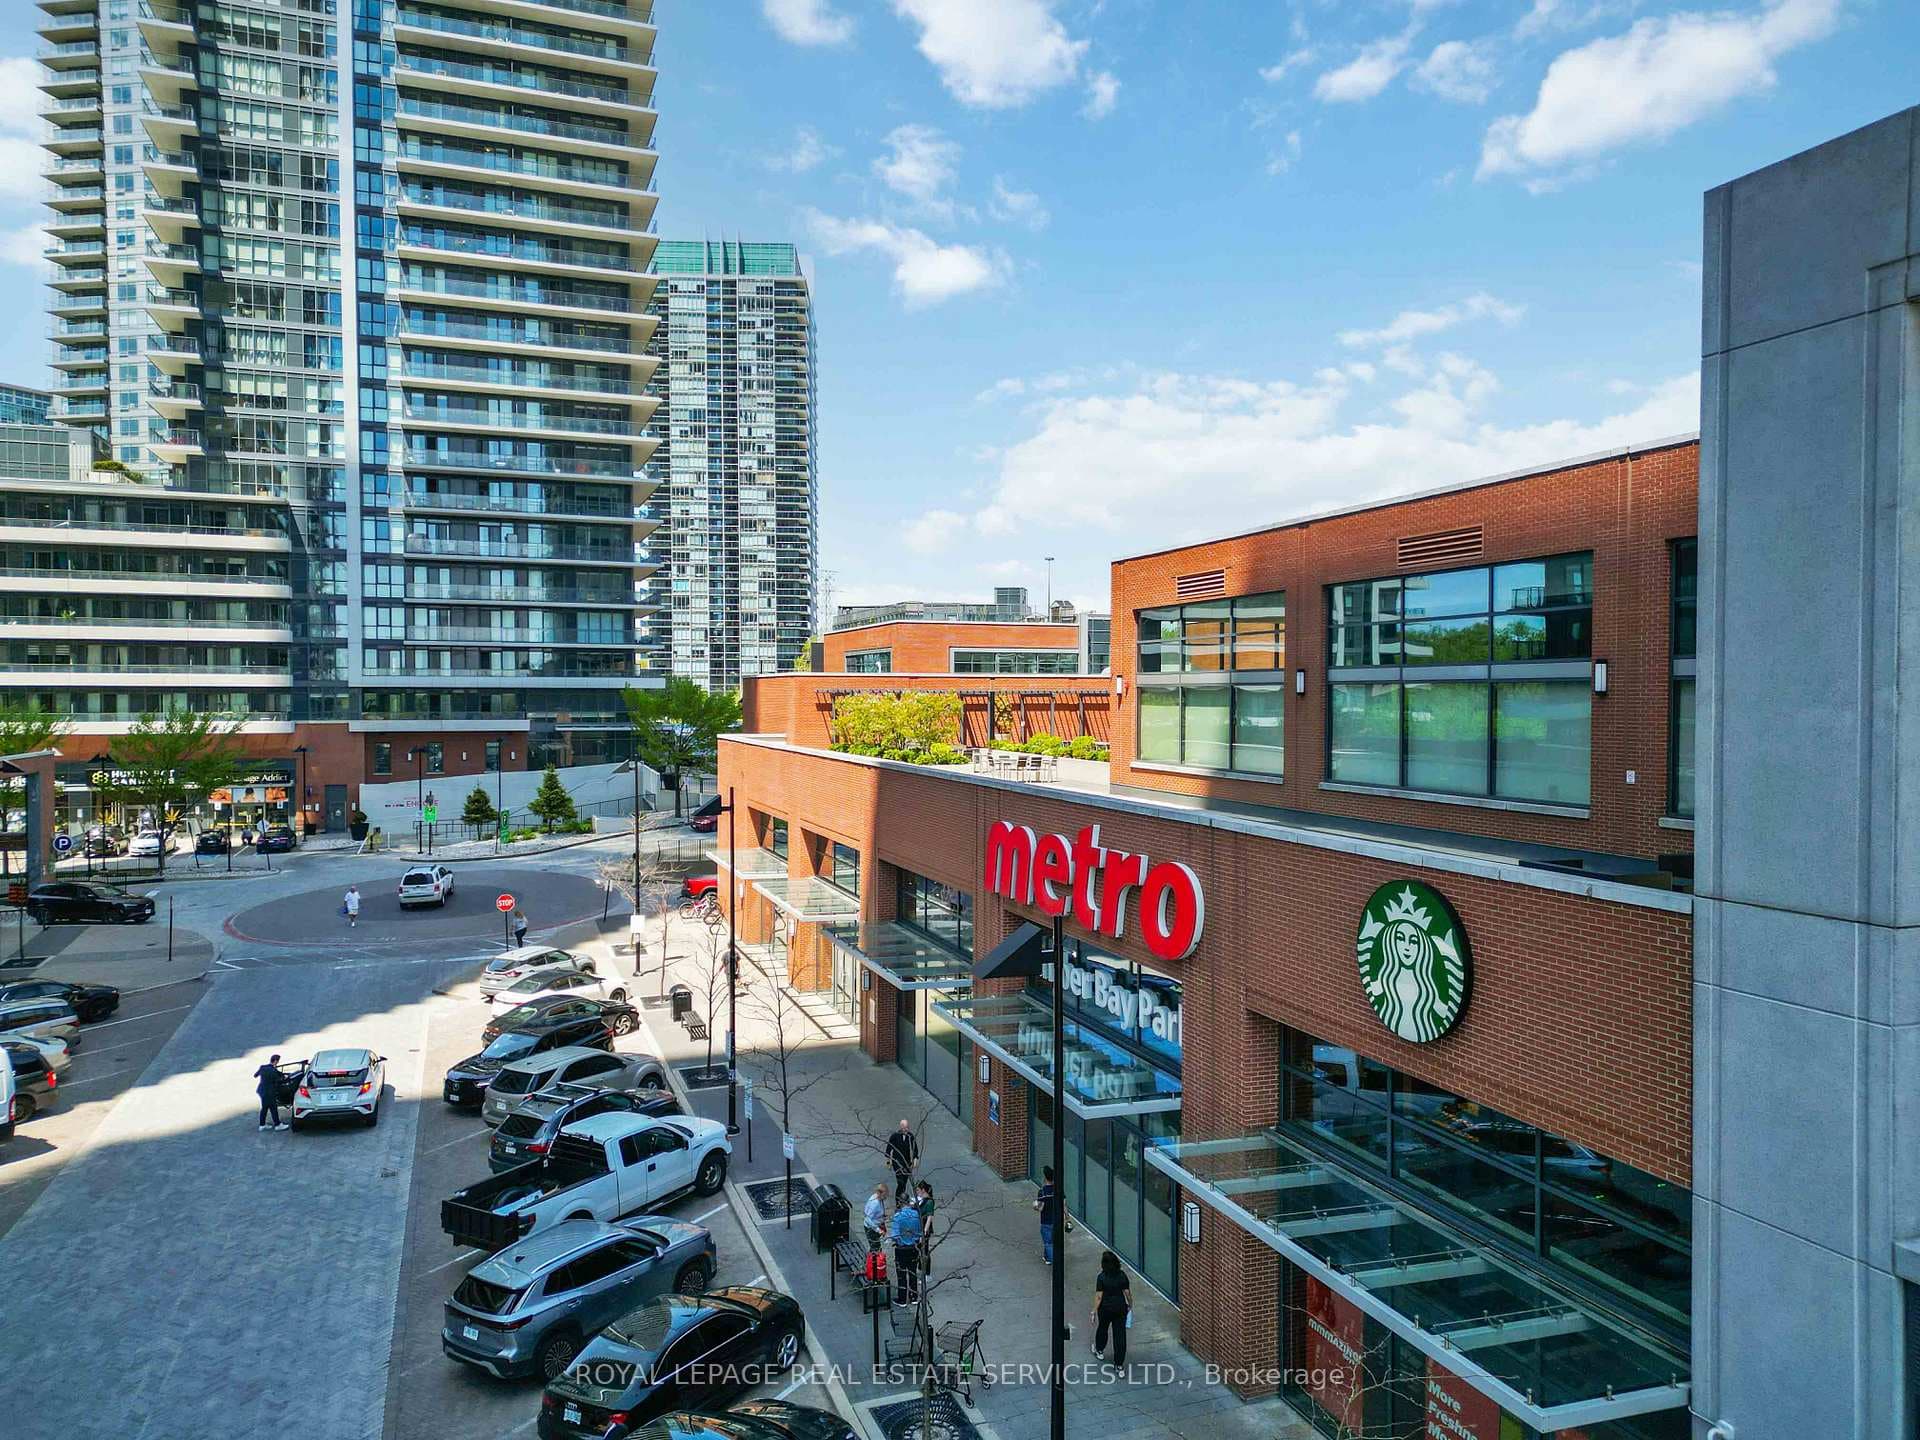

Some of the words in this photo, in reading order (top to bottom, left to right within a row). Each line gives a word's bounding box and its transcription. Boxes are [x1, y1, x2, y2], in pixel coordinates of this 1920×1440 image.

[111, 770, 149, 778] HUN
[261, 773, 288, 782] Addict
[111, 778, 175, 786] CANNAS
[59, 839, 68, 848] P
[984, 820, 1204, 961] metro
[498, 899, 513, 907] STOP
[1094, 969, 1138, 1031] Bay
[1138, 988, 1183, 1047] Par
[1428, 1380, 1462, 1413] More
[1428, 1421, 1451, 1440] Mo
